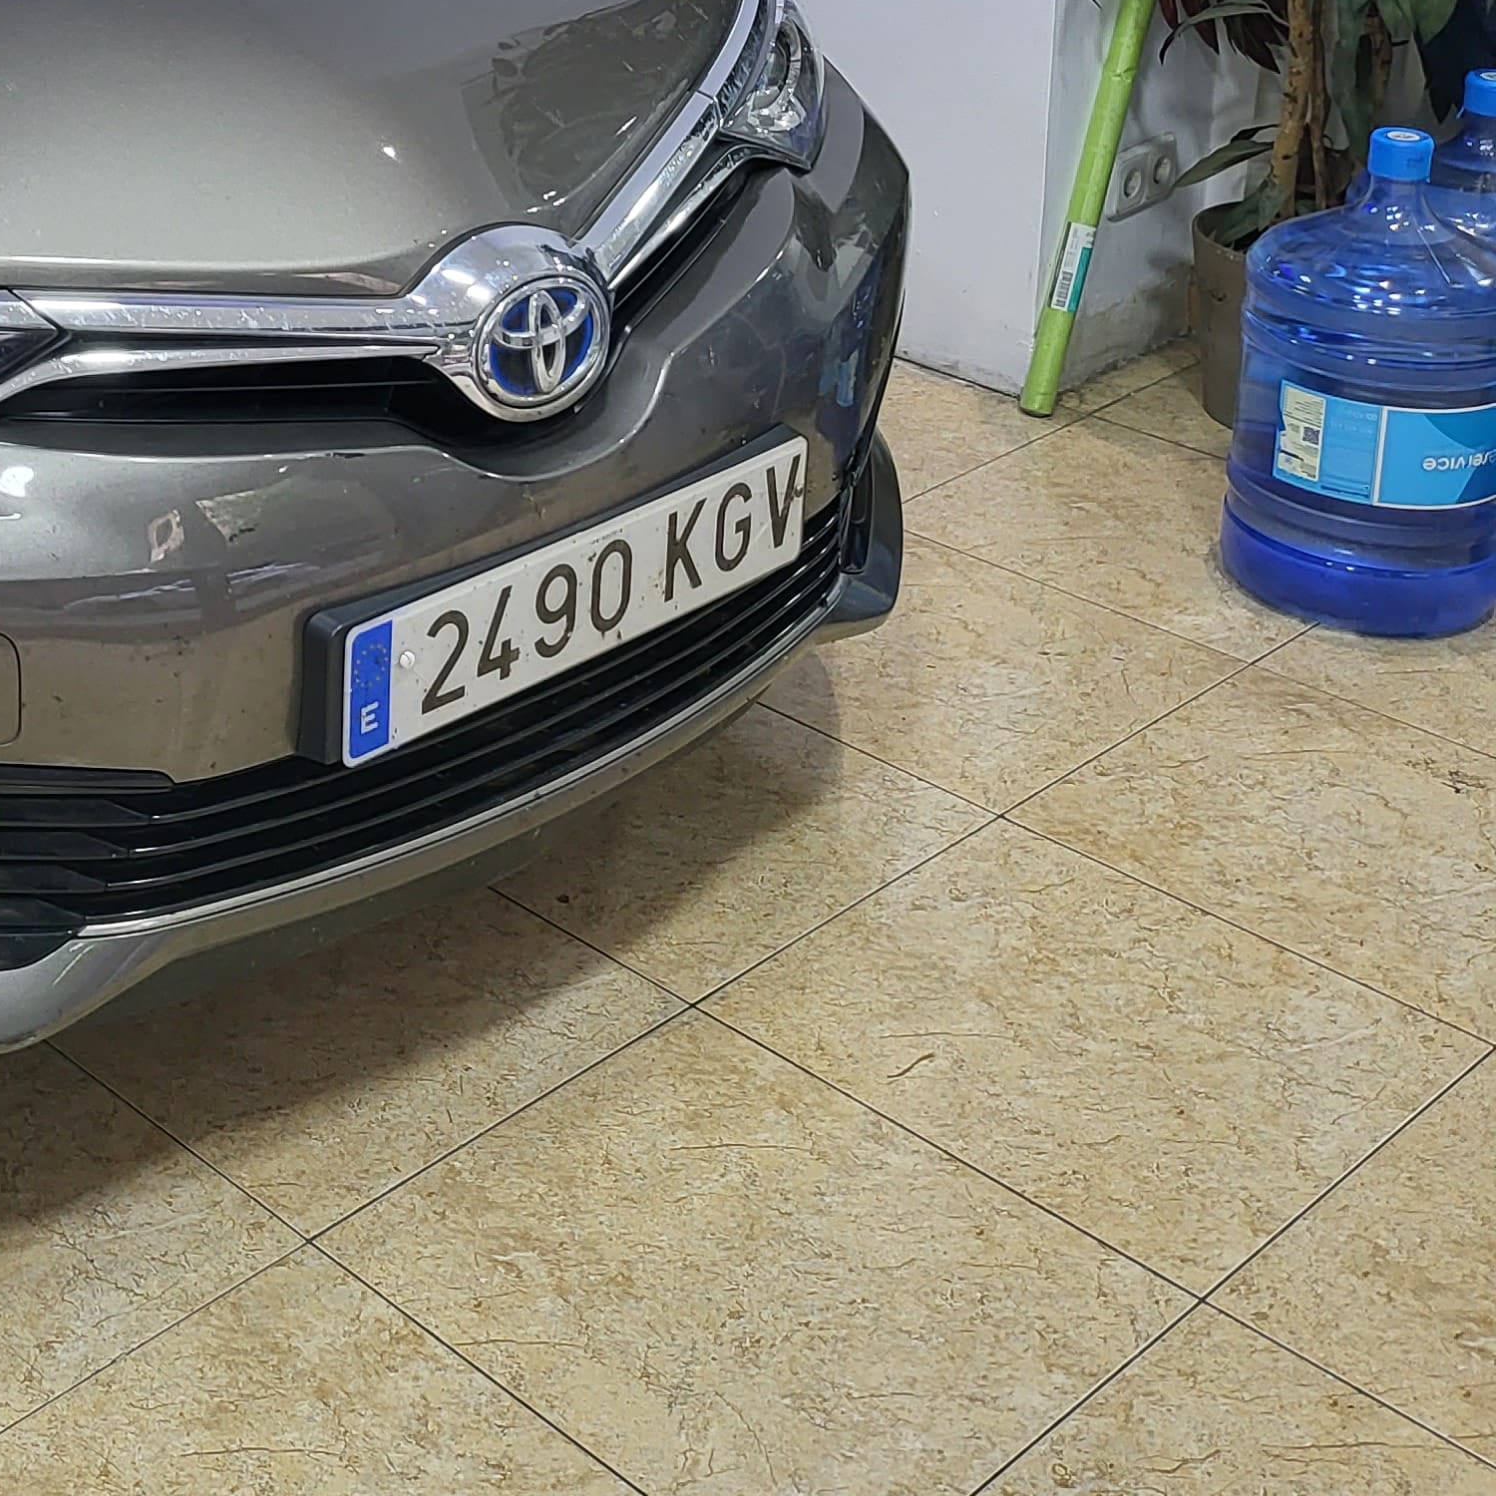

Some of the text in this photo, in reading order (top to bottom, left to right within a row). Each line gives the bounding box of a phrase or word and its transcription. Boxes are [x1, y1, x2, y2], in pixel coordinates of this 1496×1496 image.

[421, 455, 802, 715] 2490 KGV
[361, 701, 379, 735] E
